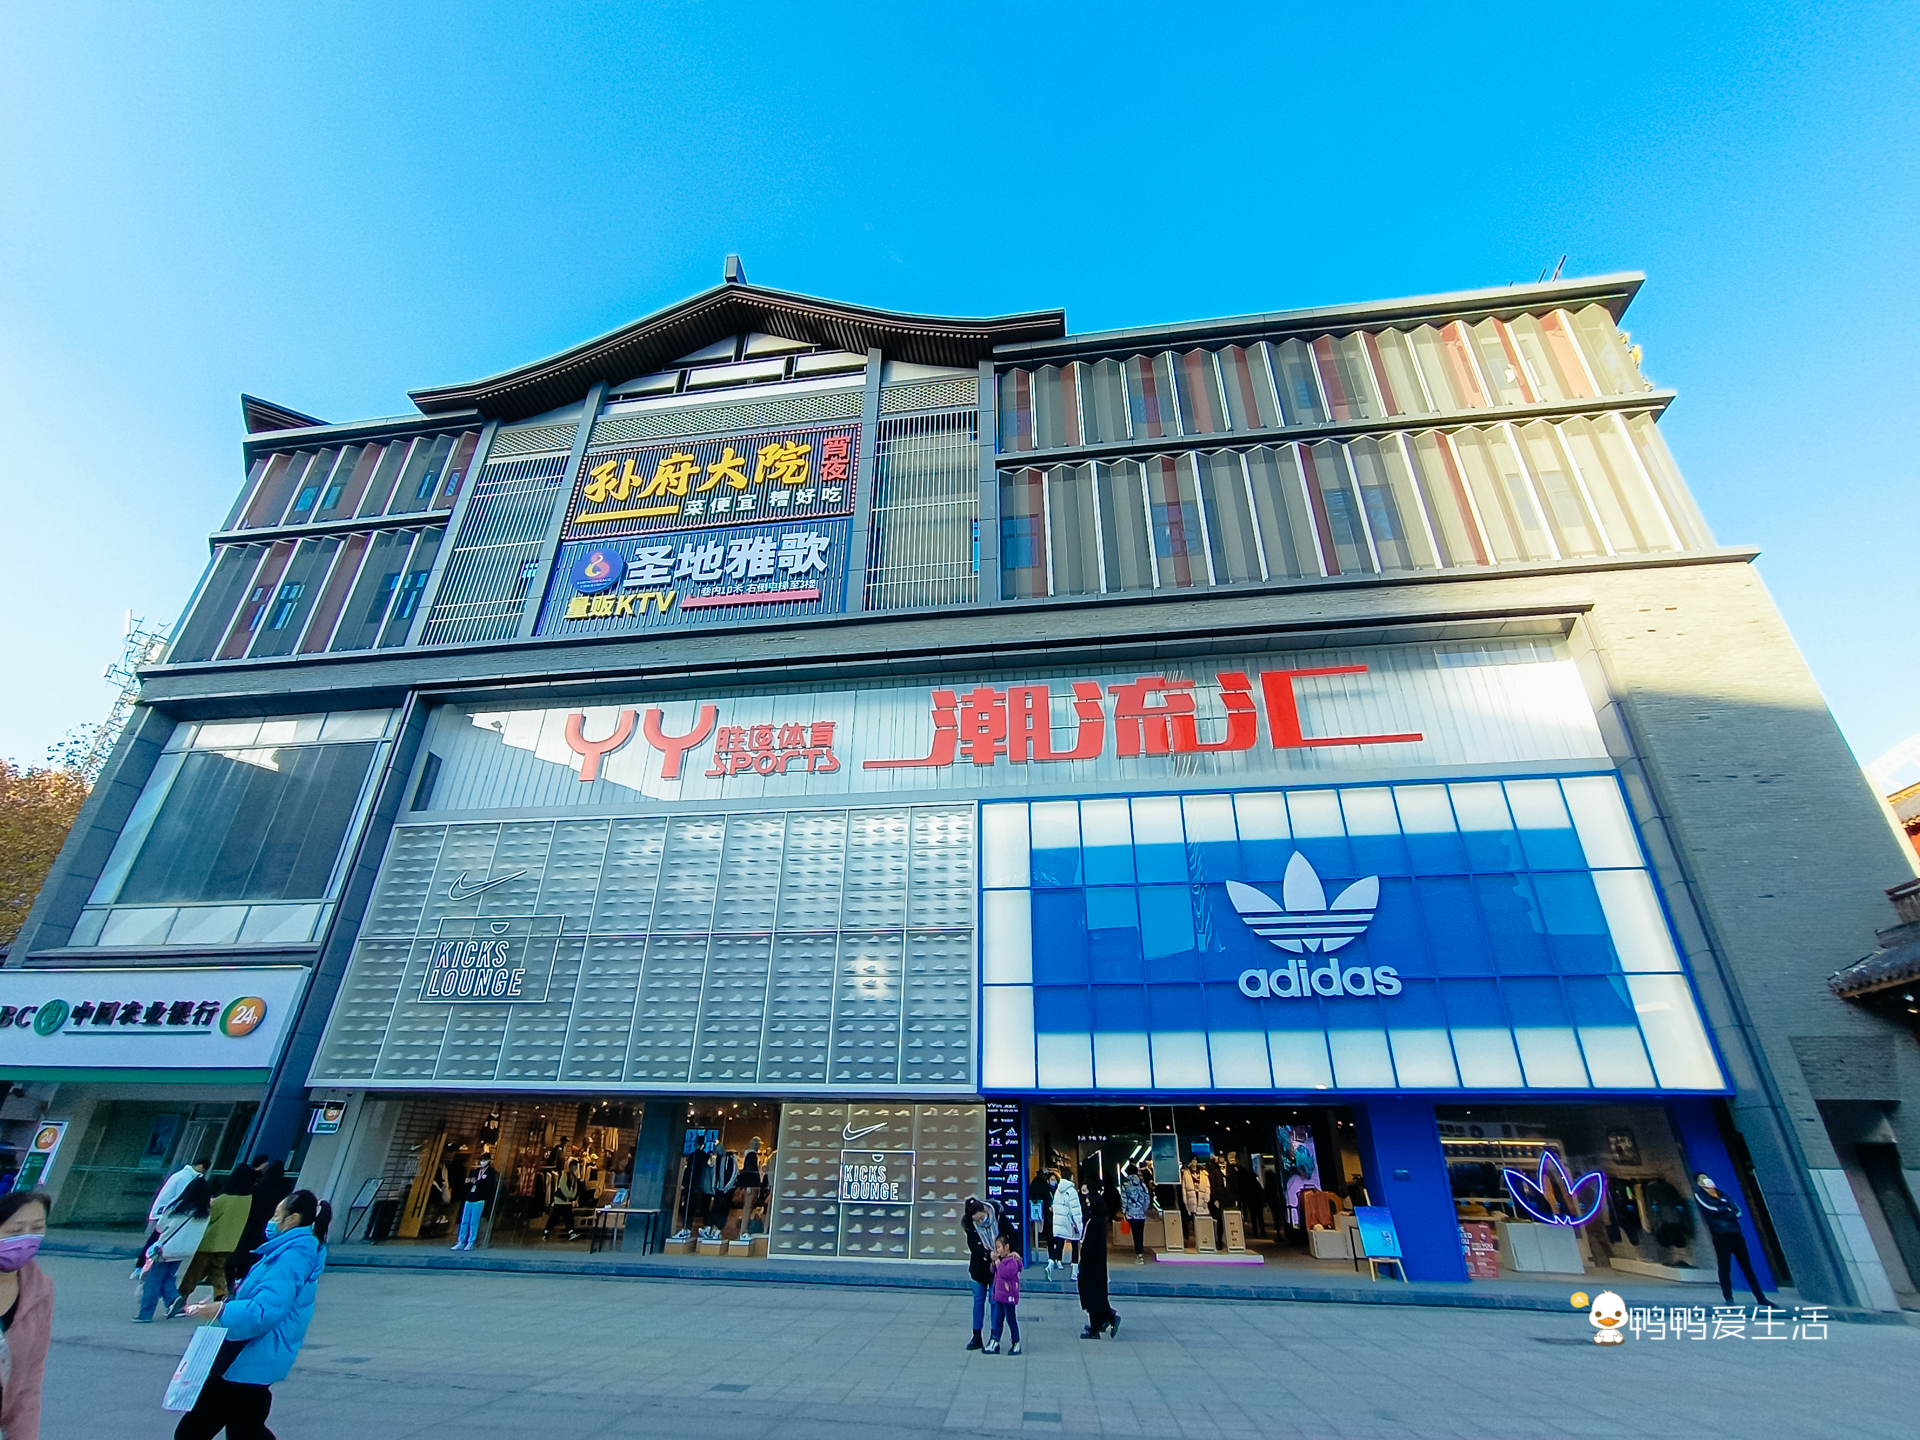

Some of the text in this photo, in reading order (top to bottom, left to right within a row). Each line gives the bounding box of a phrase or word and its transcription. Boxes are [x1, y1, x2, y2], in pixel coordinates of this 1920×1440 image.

[584, 440, 812, 502] 孙府大院
[820, 436, 851, 481] 宵夜
[622, 532, 830, 588] 圣地雅歌
[862, 664, 1423, 769] 潮流汇
[715, 721, 836, 753] 胜道体育
[434, 940, 510, 969] KICKS
[426, 967, 526, 997] LOUNGE
[1238, 957, 1402, 998] adidas
[70, 1000, 221, 1026] 中国农业银行
[843, 1164, 887, 1182] KICKS
[842, 1181, 899, 1201] LOUNGE
